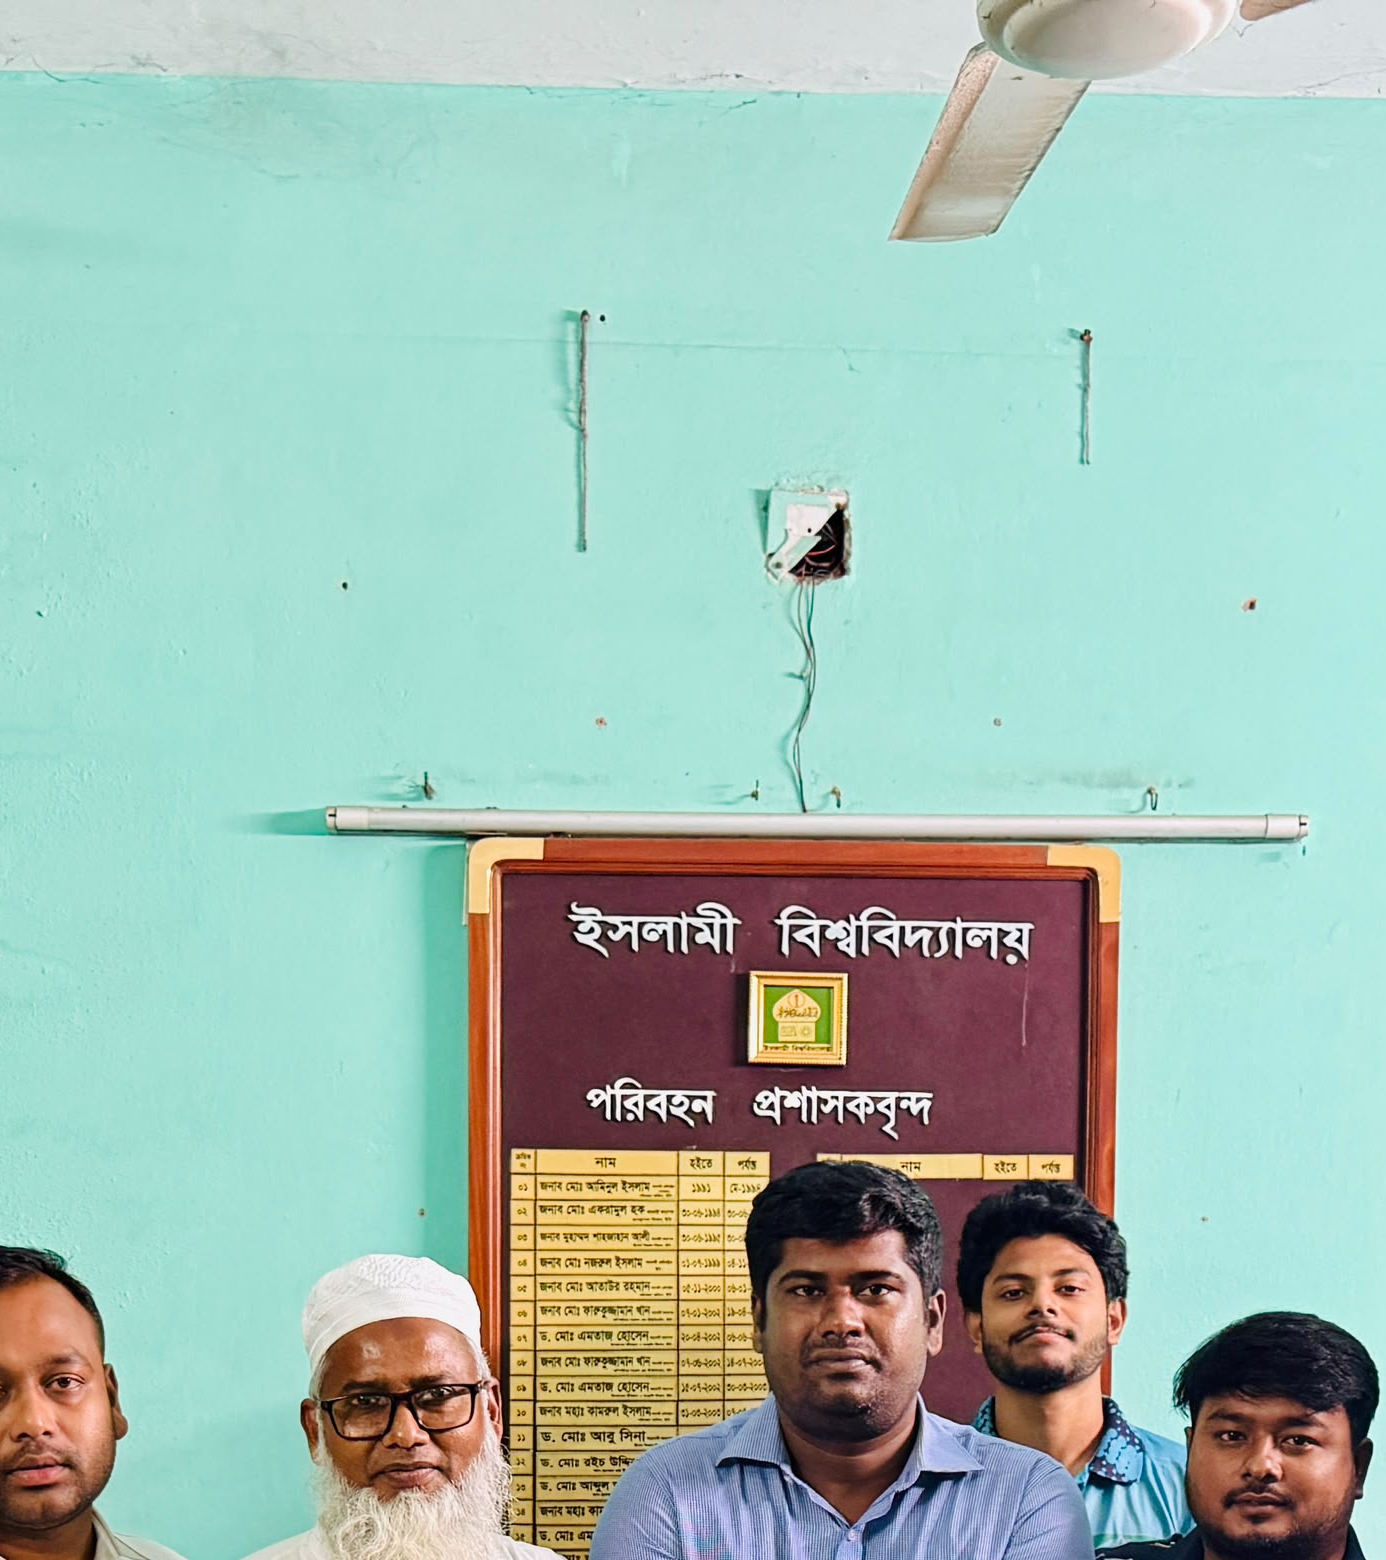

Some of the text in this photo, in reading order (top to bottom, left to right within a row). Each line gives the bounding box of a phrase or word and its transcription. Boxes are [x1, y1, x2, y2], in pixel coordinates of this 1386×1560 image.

[567, 901, 1035, 964] ইসলামী বিশ্ববিদ্যালয়
[586, 1077, 934, 1140] পরিবহন প্রশাসকবৃন্দ
[594, 1157, 616, 1168] নাম
[690, 1157, 713, 1170] হইতে
[900, 1161, 921, 1172] নাম
[540, 1181, 562, 1192] জনাব
[621, 1179, 650, 1193] ইসলাম
[539, 1205, 563, 1215] জনাব
[540, 1258, 561, 1268] জনাব
[614, 1255, 643, 1268] ইসলাম
[539, 1282, 562, 1293] জনাব
[623, 1281, 650, 1293] রহমান
[556, 1331, 574, 1342] মোঃ
[617, 1331, 649, 1342] হোসেন
[556, 1382, 574, 1393] মোঃ
[618, 1382, 649, 1393] হোসেন
[539, 1407, 561, 1417] জনাব
[622, 1404, 651, 1417] ইসলাম
[540, 1431, 555, 1442] ড.
[562, 1431, 585, 1442] মোঃ
[590, 1431, 616, 1444] আবু
[620, 1428, 646, 1442] সিনা
[540, 1459, 553, 1467] ড.
[559, 1459, 579, 1467] মোঃ
[584, 1456, 605, 1467] রইচ
[540, 1482, 552, 1491] ড.
[557, 1482, 576, 1490] মোঃ
[540, 1506, 563, 1516] জনাব
[539, 1531, 573, 1541] ড. মোঃ
